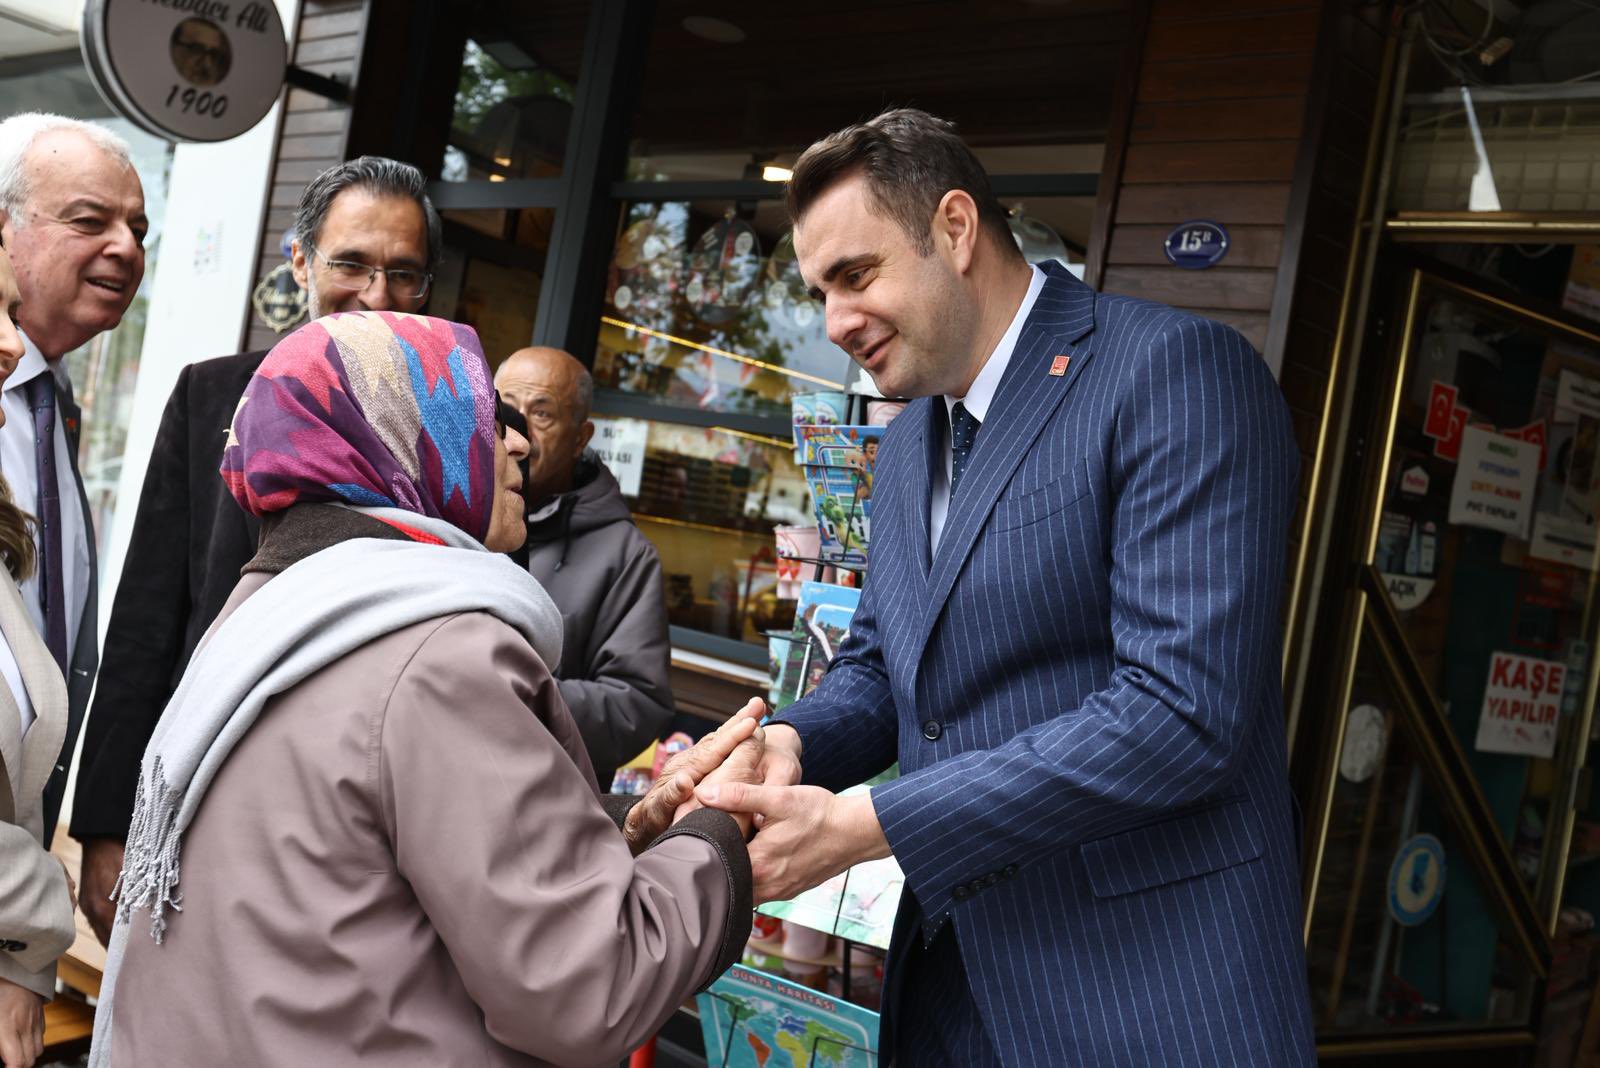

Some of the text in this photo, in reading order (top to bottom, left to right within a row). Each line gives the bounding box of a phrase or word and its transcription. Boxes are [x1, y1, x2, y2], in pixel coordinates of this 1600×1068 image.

[236, 1, 270, 33] Ali
[164, 85, 229, 119] 1900
[1389, 579, 1416, 600] AÇIK
[1492, 656, 1562, 700] KAŞE
[1487, 697, 1556, 724] YAPILIR
